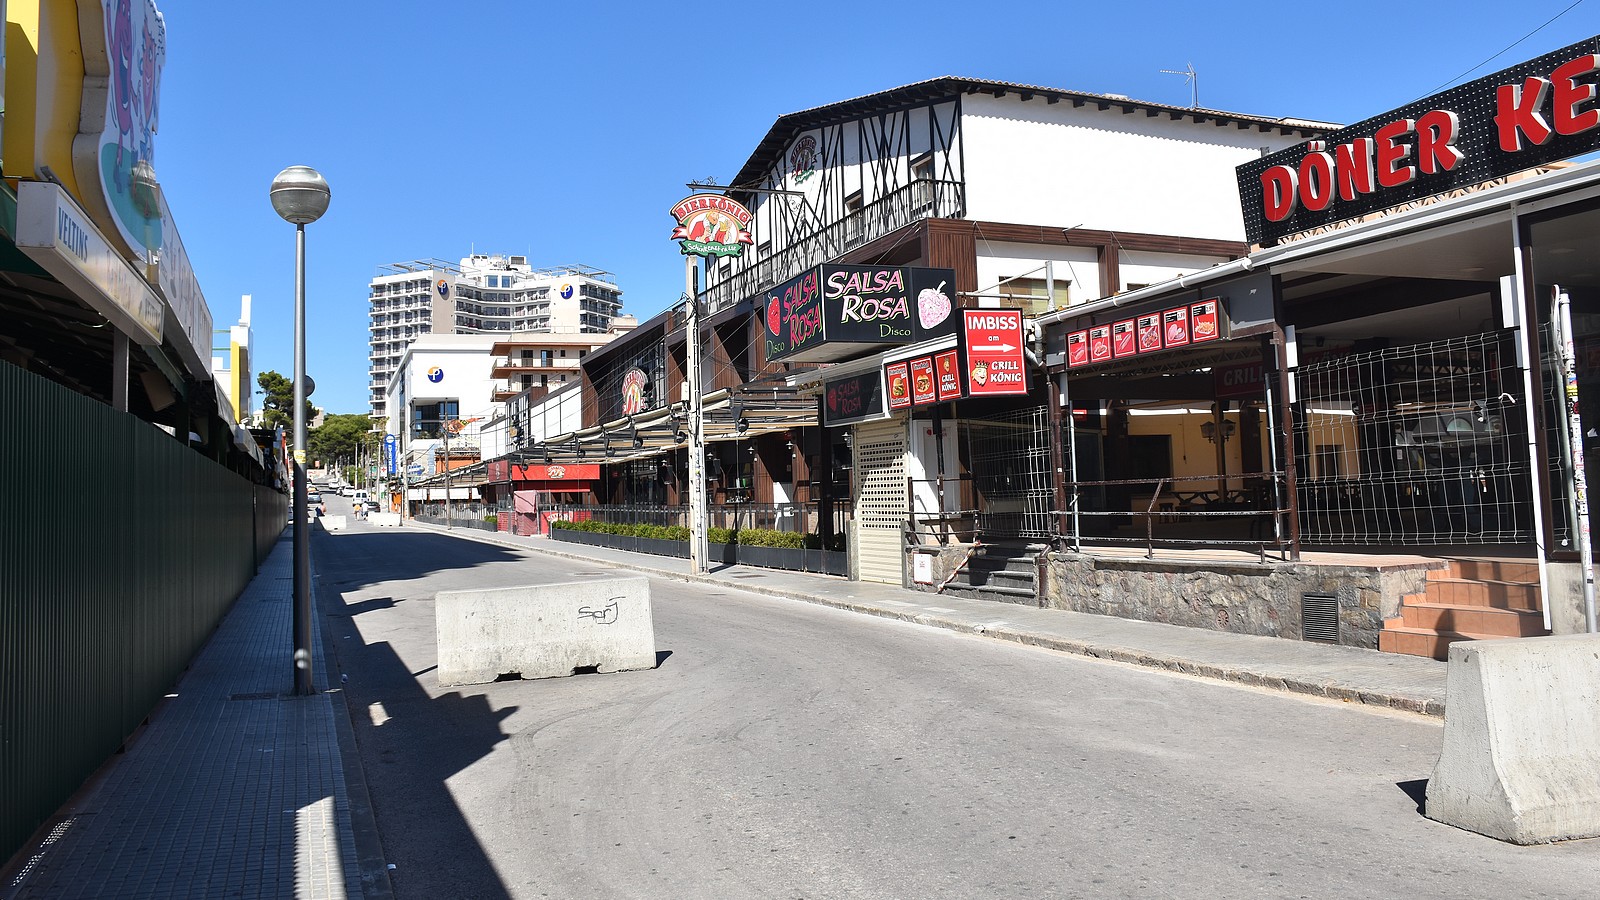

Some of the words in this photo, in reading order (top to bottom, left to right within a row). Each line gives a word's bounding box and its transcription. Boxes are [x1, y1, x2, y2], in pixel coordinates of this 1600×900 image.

[1260, 110, 1464, 222] DÖNER
[1494, 54, 1600, 152] KE
[675, 198, 749, 222] BIERKÖNIG
[58, 206, 88, 263] VELTINS
[782, 268, 819, 323] SALSA
[825, 269, 904, 299] SALSA
[841, 296, 911, 324] ROSA
[789, 303, 822, 350] ROSA
[879, 324, 911, 338] Disco
[968, 316, 1018, 330] IMBISS
[990, 371, 1022, 382] KÖNIG
[991, 361, 1019, 370] GRILL
[1224, 365, 1264, 386] GRILL
[838, 380, 860, 401] SALSA
